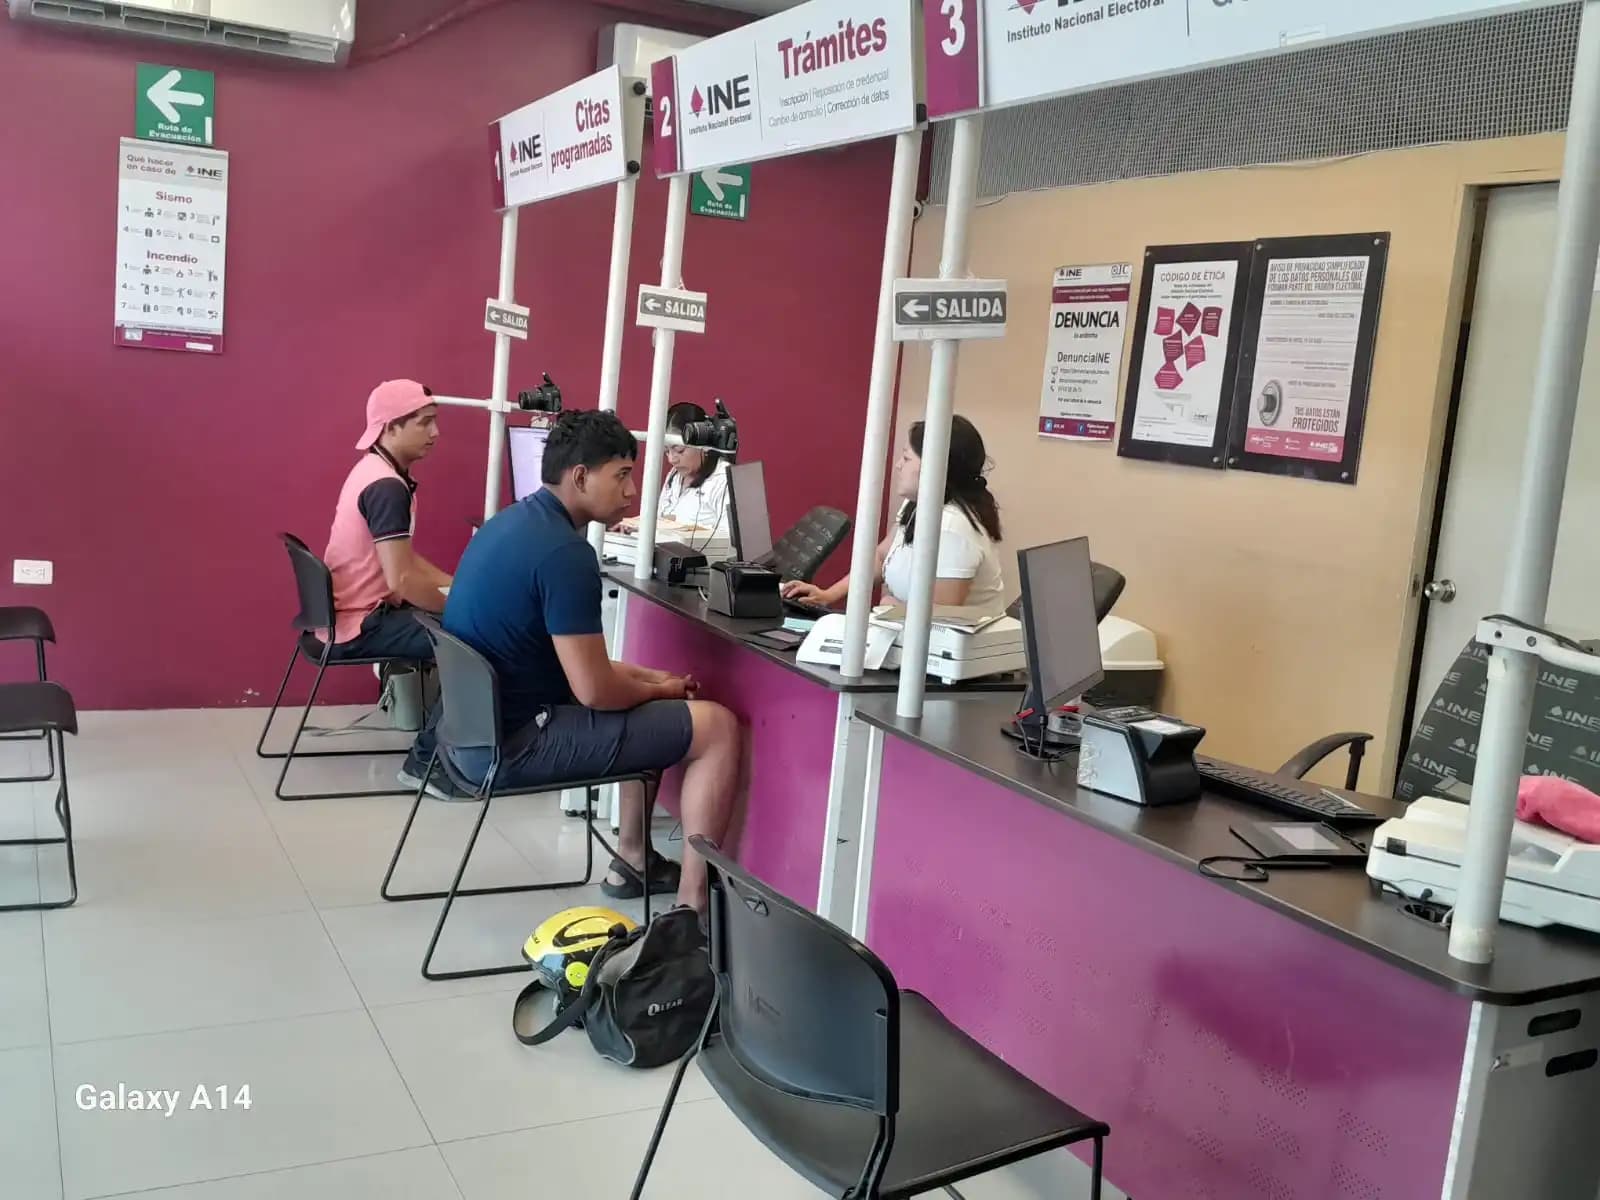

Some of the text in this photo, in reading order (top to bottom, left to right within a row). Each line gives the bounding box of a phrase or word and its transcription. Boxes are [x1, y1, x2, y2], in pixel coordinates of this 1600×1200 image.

[940, 0, 966, 57] 3
[1007, 22, 1051, 43] Instituto
[1054, 6, 1104, 32] Nacional
[777, 16, 888, 80] Trámites
[707, 74, 751, 116] INE
[861, 93, 870, 105] de
[871, 89, 890, 104] datos
[575, 98, 610, 132] Citas
[659, 95, 672, 137] 2
[148, 129, 202, 143] Evacuación
[157, 122, 193, 134] Ruta de
[518, 134, 542, 163] INE
[550, 132, 613, 174] programadas
[140, 165, 162, 173] caso
[164, 167, 176, 175] de
[147, 156, 174, 166] hacer
[197, 167, 223, 177] INE
[155, 190, 193, 204] Sismo
[146, 250, 198, 264] Incendio
[1065, 268, 1083, 277] INE
[1192, 271, 1202, 281] DE
[664, 299, 705, 319] SALIDA
[936, 297, 1003, 319] SALIDA
[502, 312, 528, 329] SALIDA
[1054, 310, 1120, 329] DENUNCIA
[1057, 351, 1111, 364] DenunciaINE
[1291, 417, 1340, 433] PROTEGIDOS
[1541, 671, 1579, 690] INE
[1447, 702, 1482, 722] INE
[1564, 710, 1600, 730] INE
[1422, 757, 1458, 778] INE
